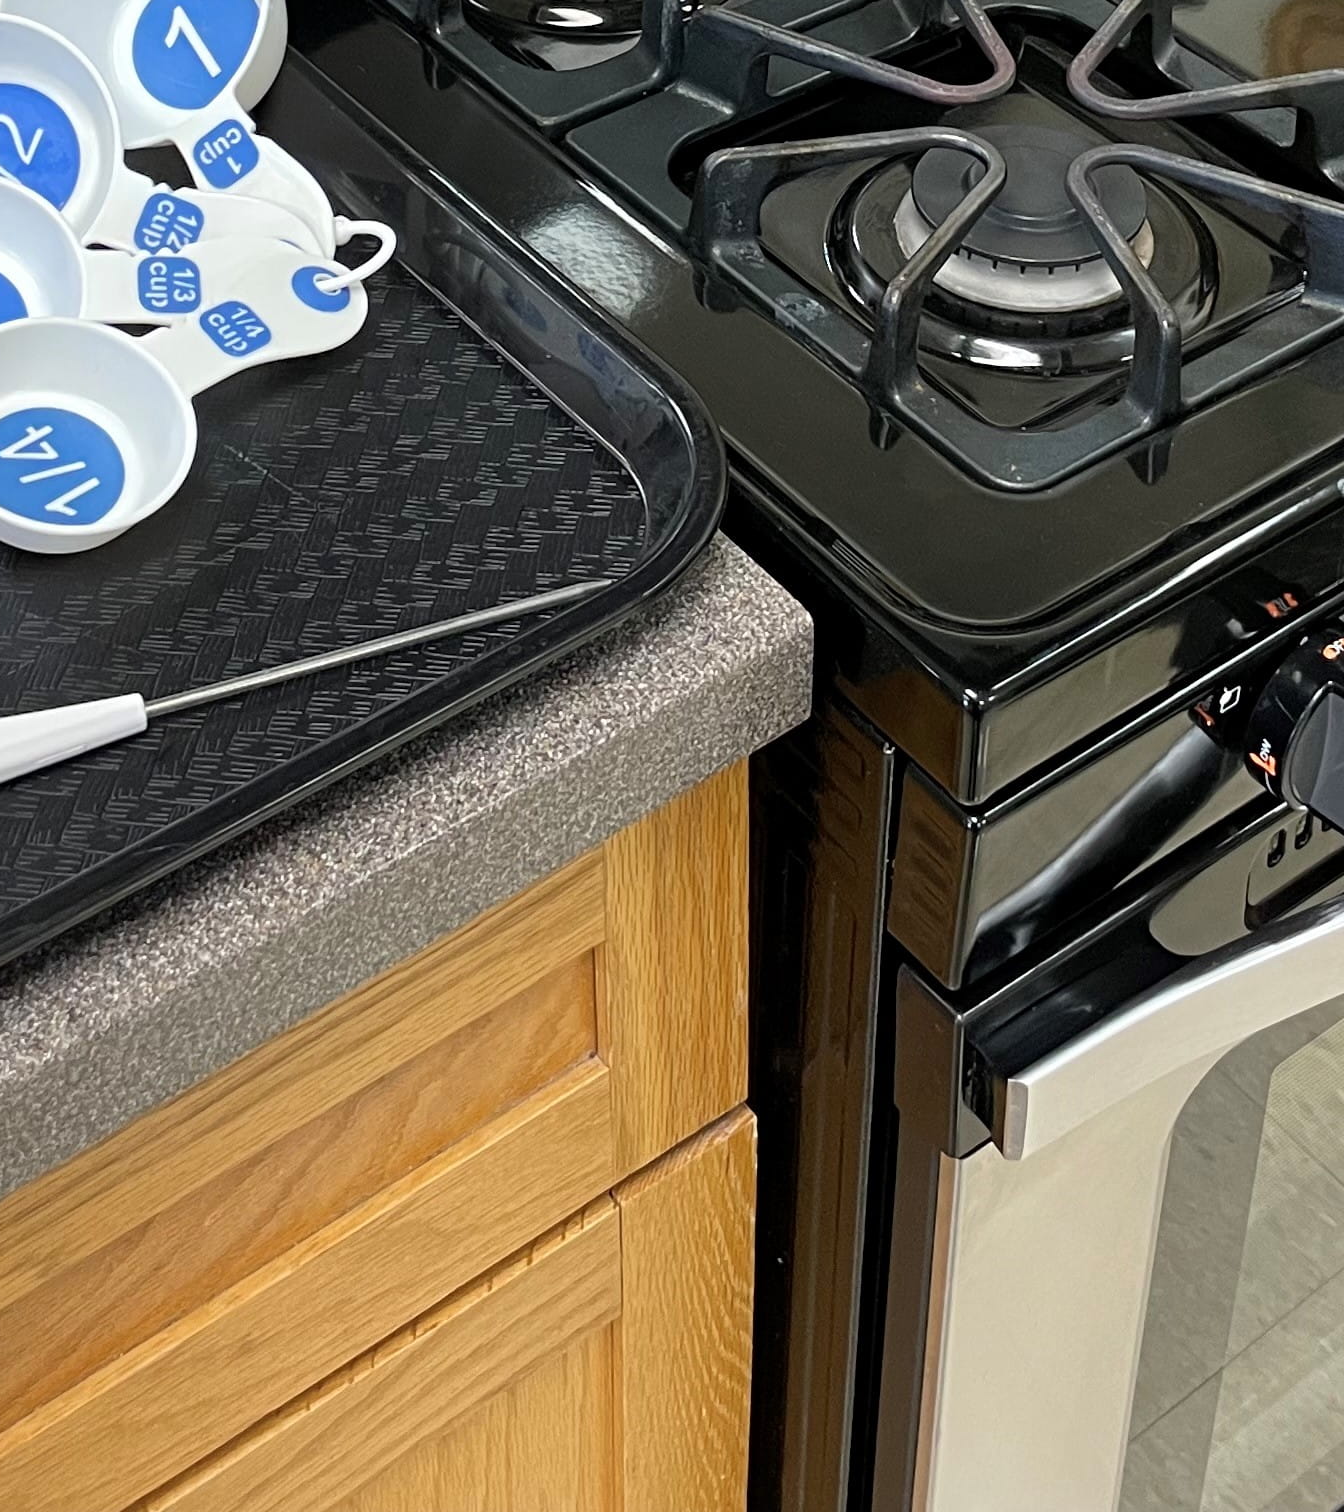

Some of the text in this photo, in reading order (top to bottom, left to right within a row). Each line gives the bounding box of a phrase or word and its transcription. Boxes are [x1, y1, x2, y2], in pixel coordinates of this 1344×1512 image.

[164, 5, 222, 78] 1
[199, 127, 243, 166] cup
[226, 156, 243, 175] 1
[142, 199, 175, 248] cup
[166, 213, 199, 254] 1/2
[145, 261, 169, 308] cup
[172, 268, 197, 303] 1/3
[207, 312, 248, 352] cup
[230, 306, 265, 339] 1/4
